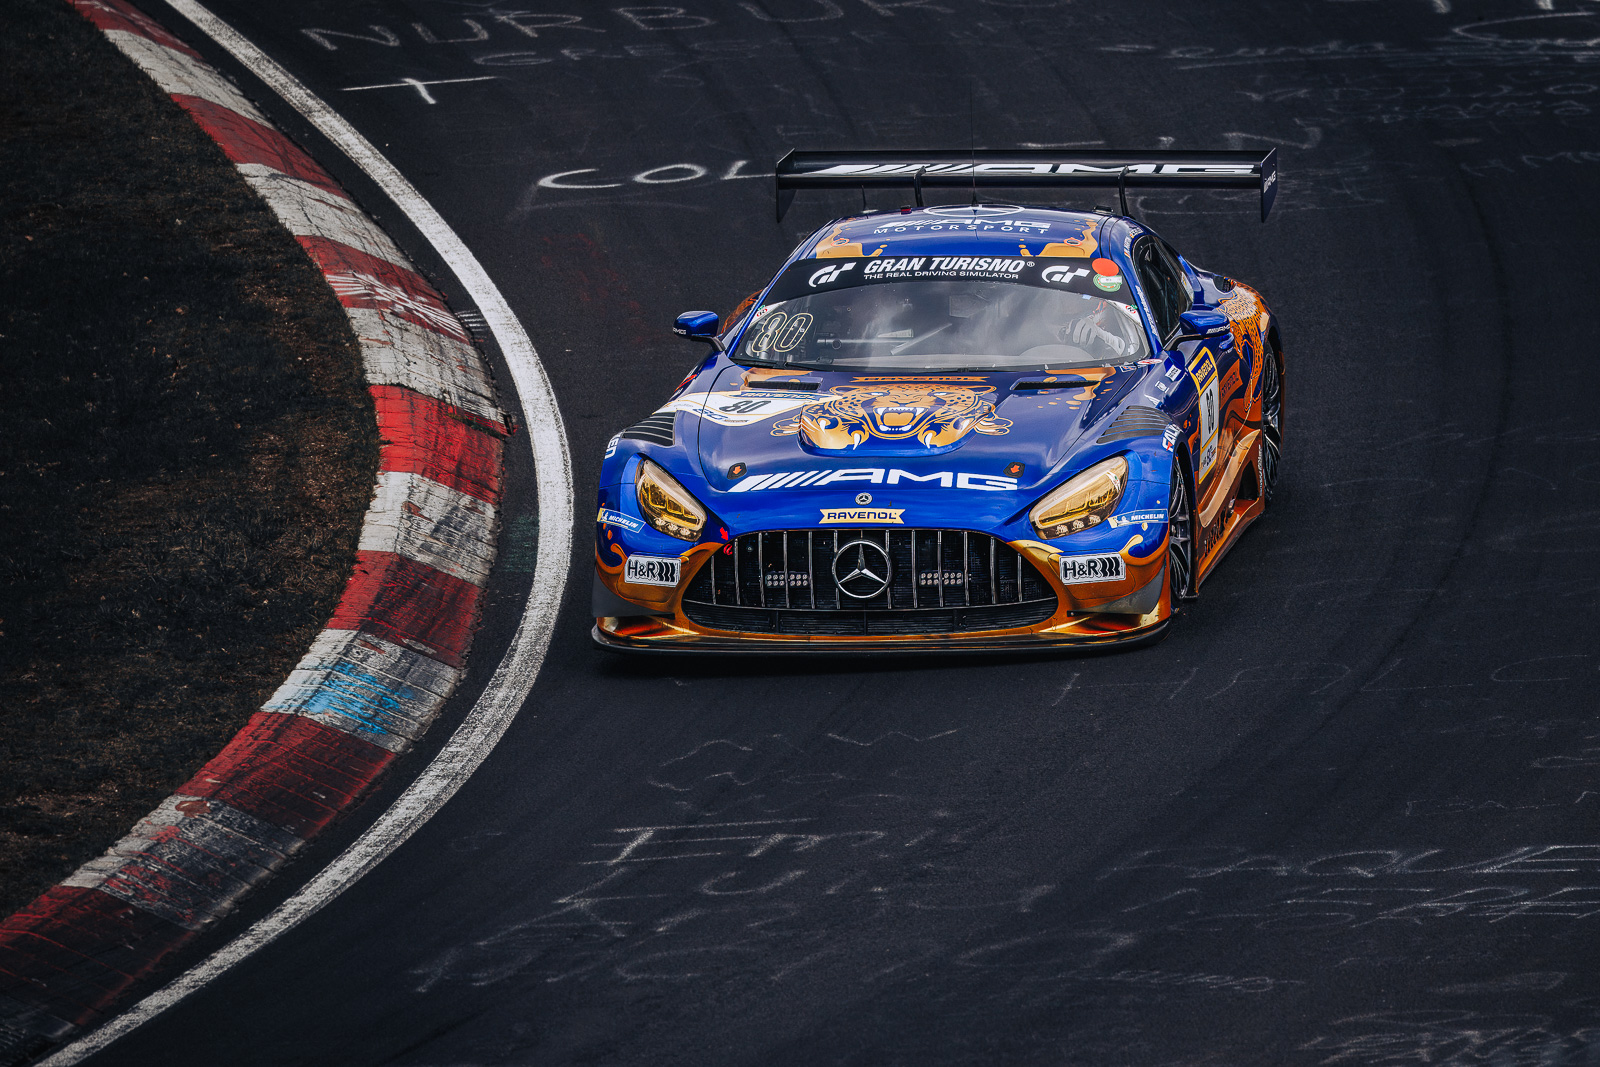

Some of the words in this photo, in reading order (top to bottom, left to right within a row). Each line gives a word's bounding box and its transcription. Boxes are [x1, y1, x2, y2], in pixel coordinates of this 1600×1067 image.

[955, 163, 1254, 174] AMG
[873, 225, 1049, 235] MOTORSPORT
[863, 257, 927, 274] GRAN
[959, 271, 1019, 279] SIMULATOR
[751, 312, 814, 353] 80
[718, 400, 771, 413] 80
[814, 468, 1018, 491] AMG
[608, 514, 639, 529] MICHELIN
[826, 510, 897, 521] RAVENOL
[1131, 513, 1165, 521] MICHELIN
[627, 558, 657, 580] H&R
[1063, 558, 1101, 580] H&R
